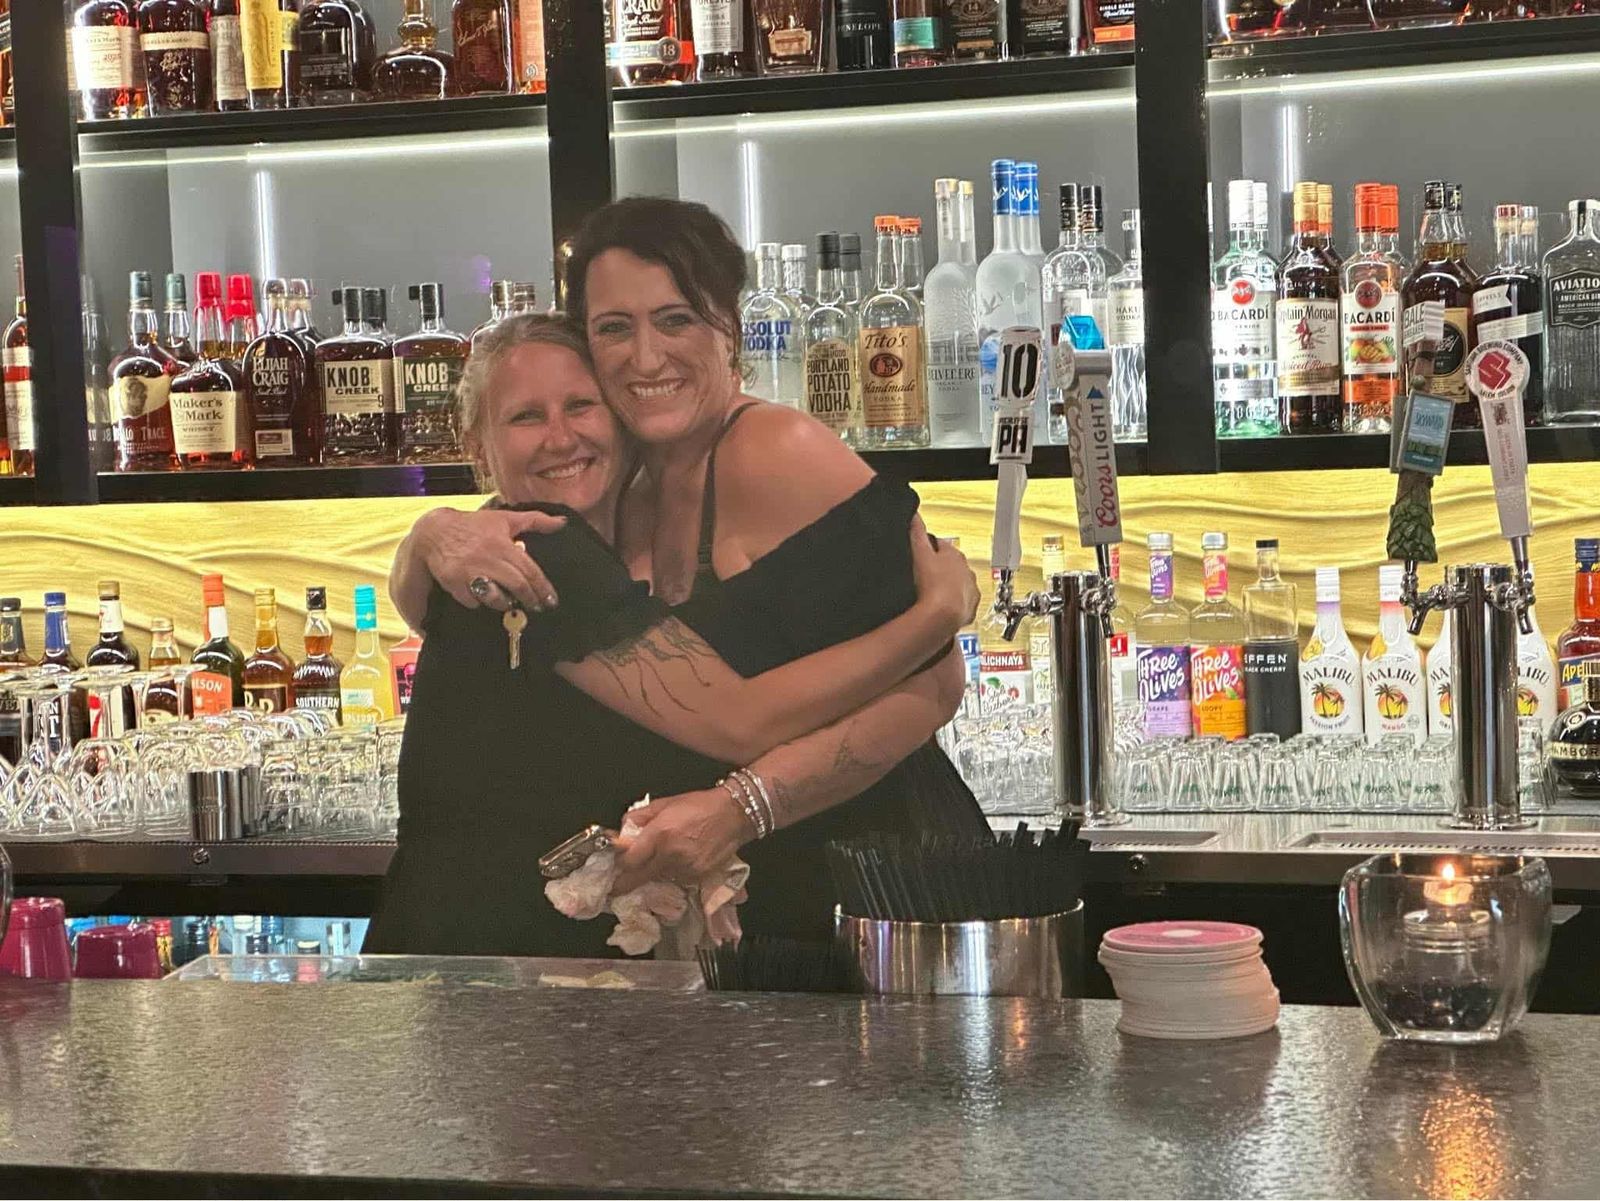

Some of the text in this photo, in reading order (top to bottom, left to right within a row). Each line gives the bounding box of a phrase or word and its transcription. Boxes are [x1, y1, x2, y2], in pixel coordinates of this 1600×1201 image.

[662, 44, 676, 56] 18
[865, 332, 909, 350] Tito's
[253, 356, 289, 371] ELIJAH
[404, 362, 449, 385] KNOB
[806, 358, 850, 374] PORTLAND
[1000, 343, 1038, 399] 10
[252, 371, 289, 387] CRAIG
[326, 366, 370, 388] KNOB
[807, 372, 851, 393] POTATO
[863, 379, 916, 394] Handmade
[335, 387, 380, 395] CREEK
[413, 384, 450, 393] CREE
[809, 393, 852, 413] VODKA
[1090, 403, 1110, 461] LIGHT
[1137, 649, 1179, 682] THREE
[1190, 647, 1232, 680] THREE
[1139, 667, 1185, 705] OLIVES
[1193, 667, 1239, 705] OLIVES
[1302, 666, 1356, 686] MALIBU
[1366, 667, 1419, 687] MALIBU
[295, 696, 340, 708] SOUTHERN
